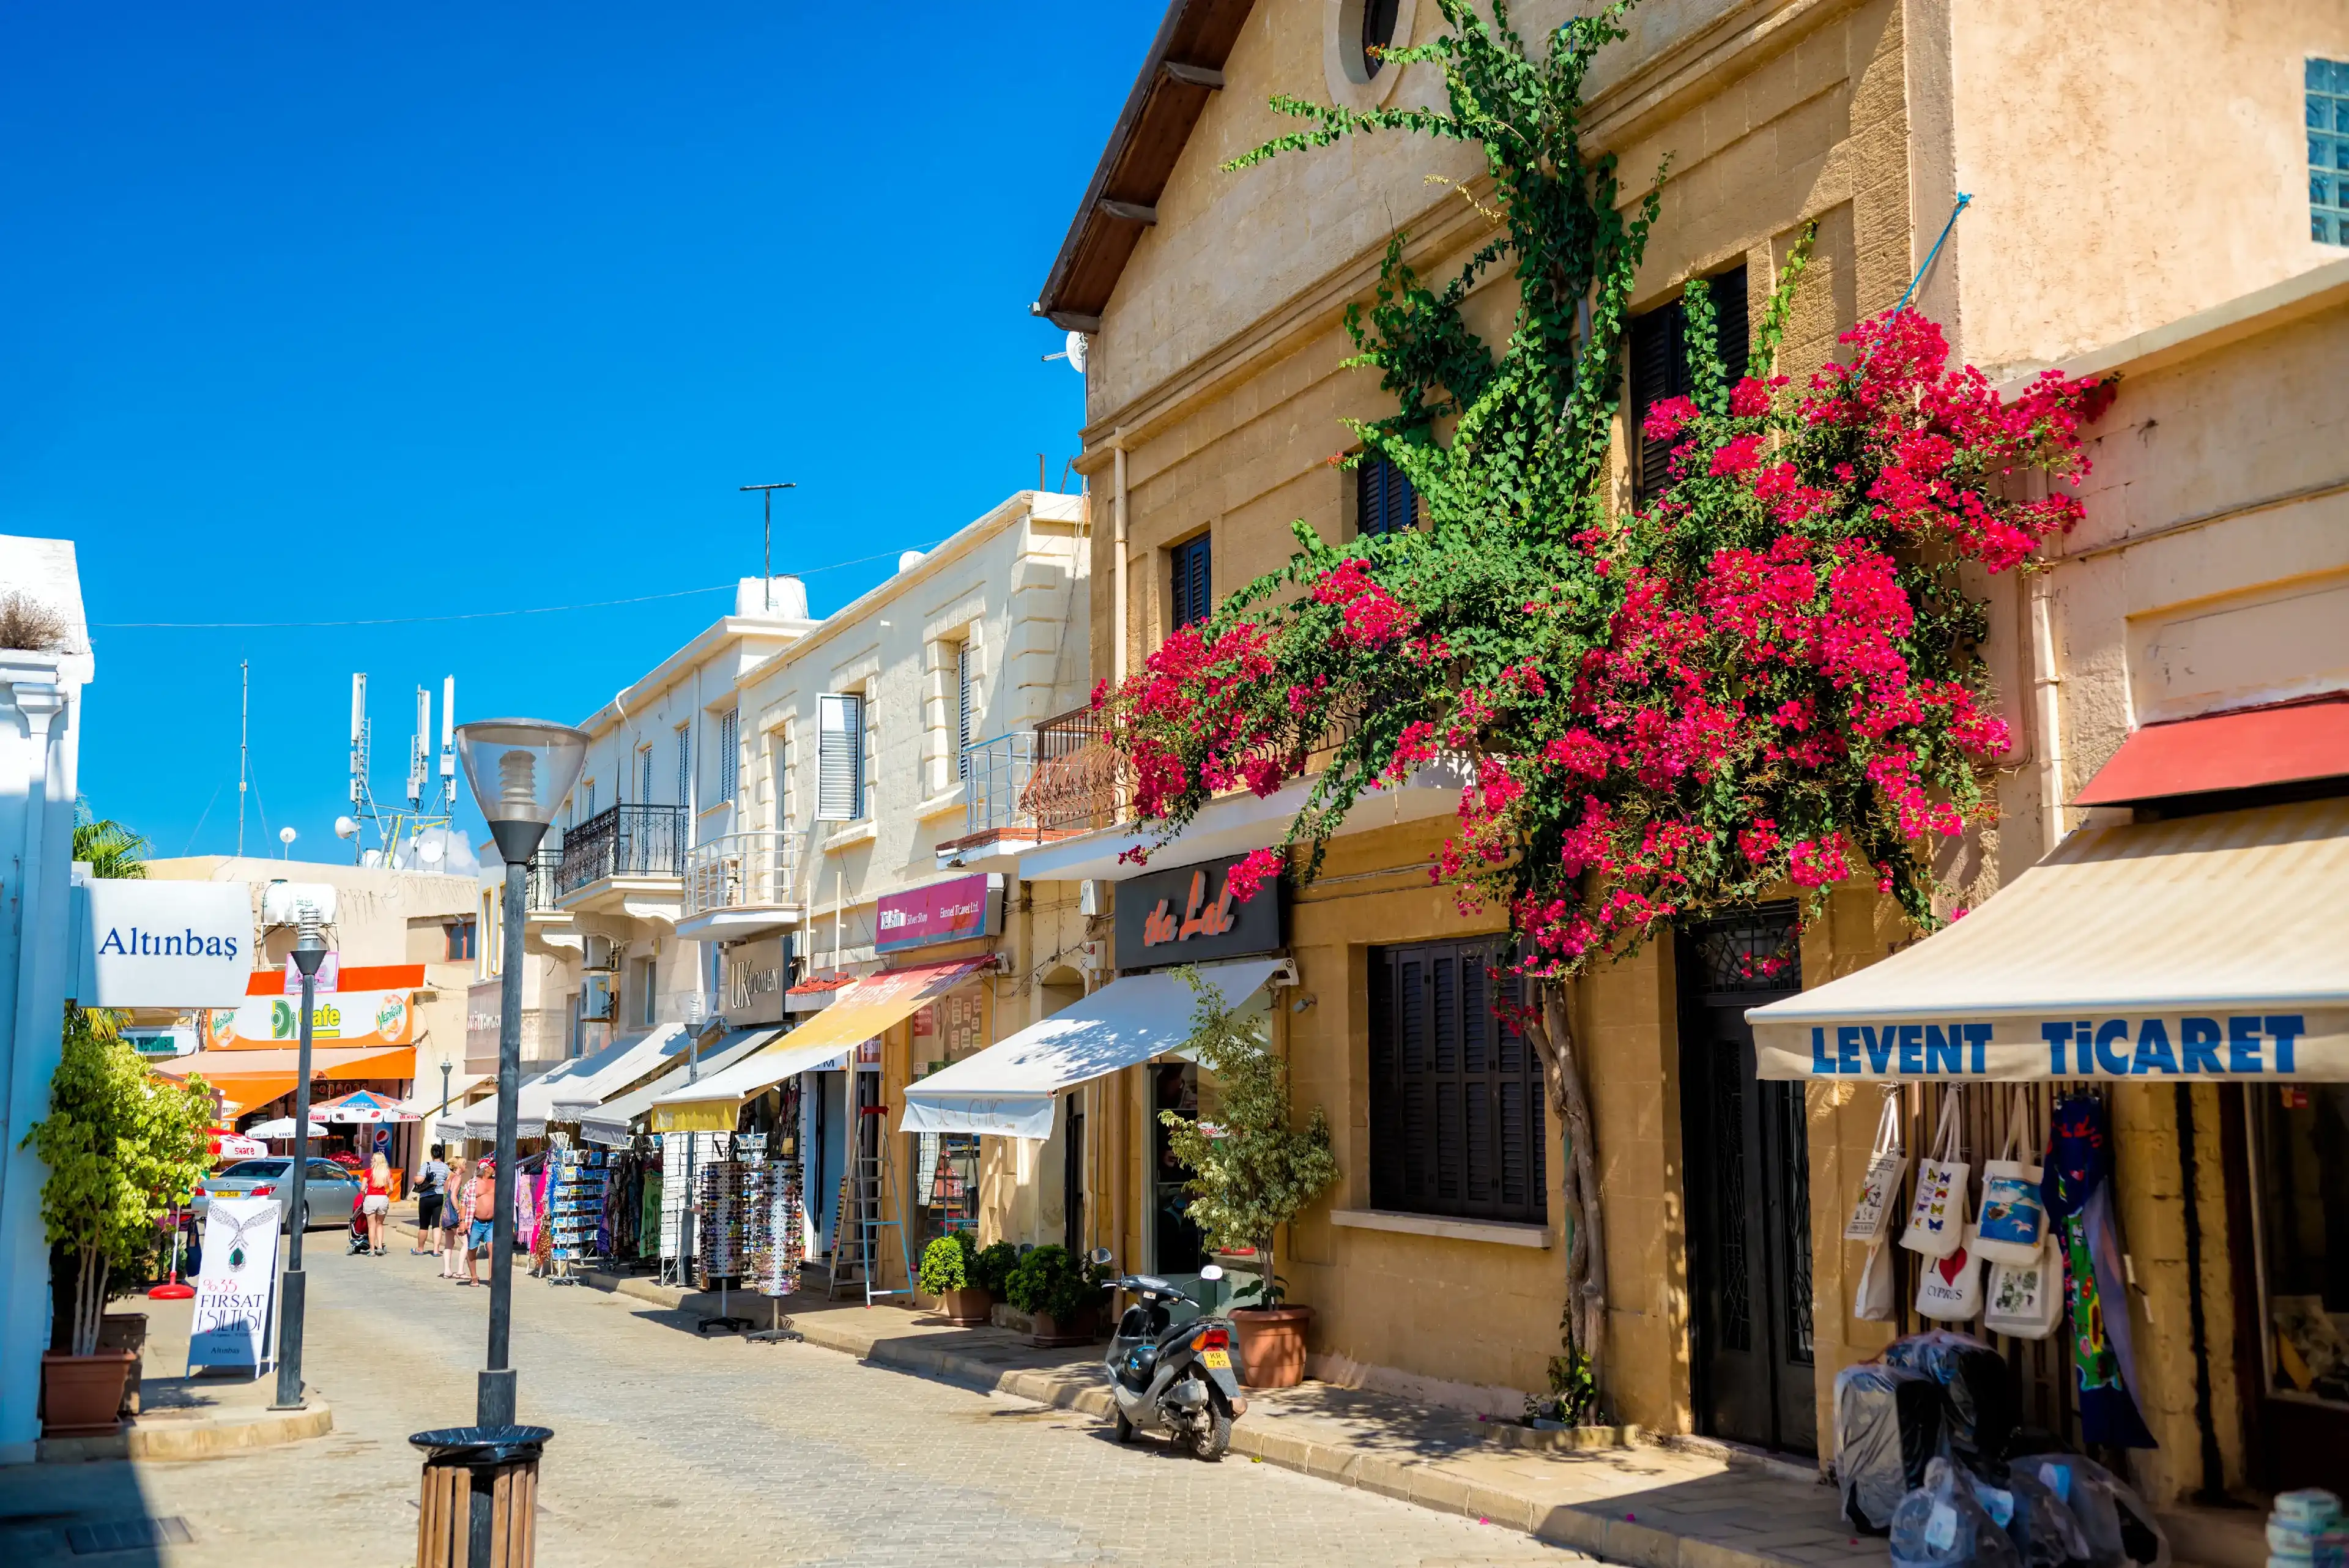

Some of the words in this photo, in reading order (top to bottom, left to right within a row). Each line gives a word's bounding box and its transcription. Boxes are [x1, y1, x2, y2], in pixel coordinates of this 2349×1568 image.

[907, 914, 918, 925] Silver
[918, 912, 927, 924] Shop
[955, 904, 970, 916] Ticaret
[970, 901, 979, 913] Ltd.
[1143, 899, 1178, 946] the
[98, 927, 237, 961] Altınbaş
[747, 968, 779, 995] WOMEN
[298, 1003, 341, 1027] afe
[1812, 1024, 1993, 1075] LEVENT
[1928, 1257, 1938, 1274] I
[201, 1294, 264, 1308] FIRSAT
[1927, 1285, 1963, 1301] CYPRUS
